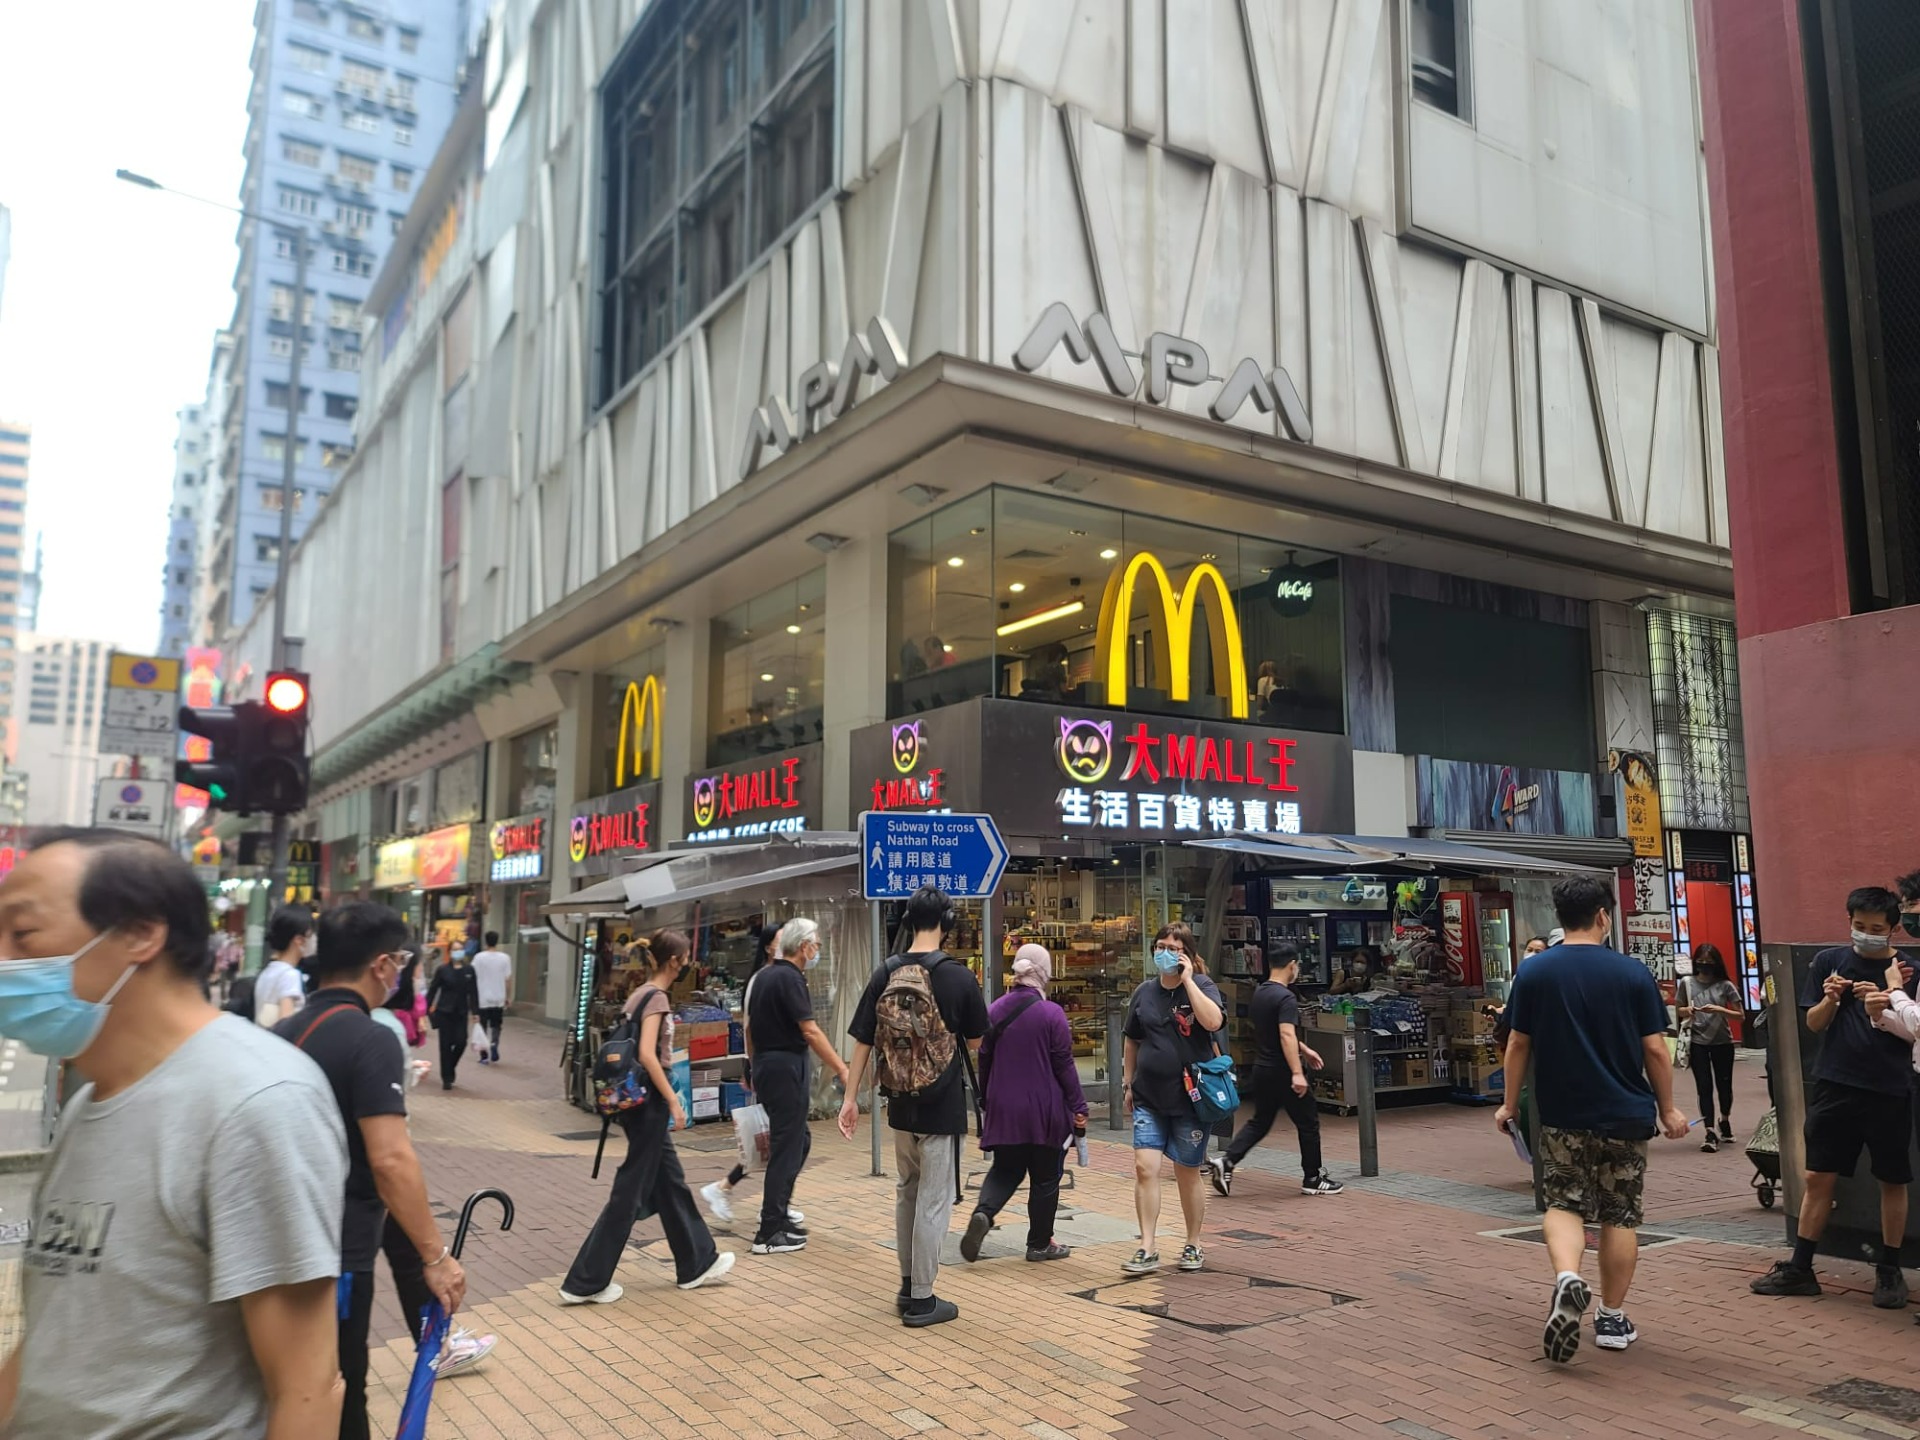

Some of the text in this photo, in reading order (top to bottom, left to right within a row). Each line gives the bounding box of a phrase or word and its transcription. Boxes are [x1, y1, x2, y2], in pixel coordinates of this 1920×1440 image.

[1122, 723, 1299, 792] 大MALL王
[718, 758, 799, 820] 大MALL王
[1062, 787, 1301, 835] 生活百貨特賣場
[588, 803, 648, 857] 大MALL王
[887, 820, 975, 835] Subway to cross
[887, 834, 959, 847] Nathan Road
[887, 851, 953, 869] 請用隧道
